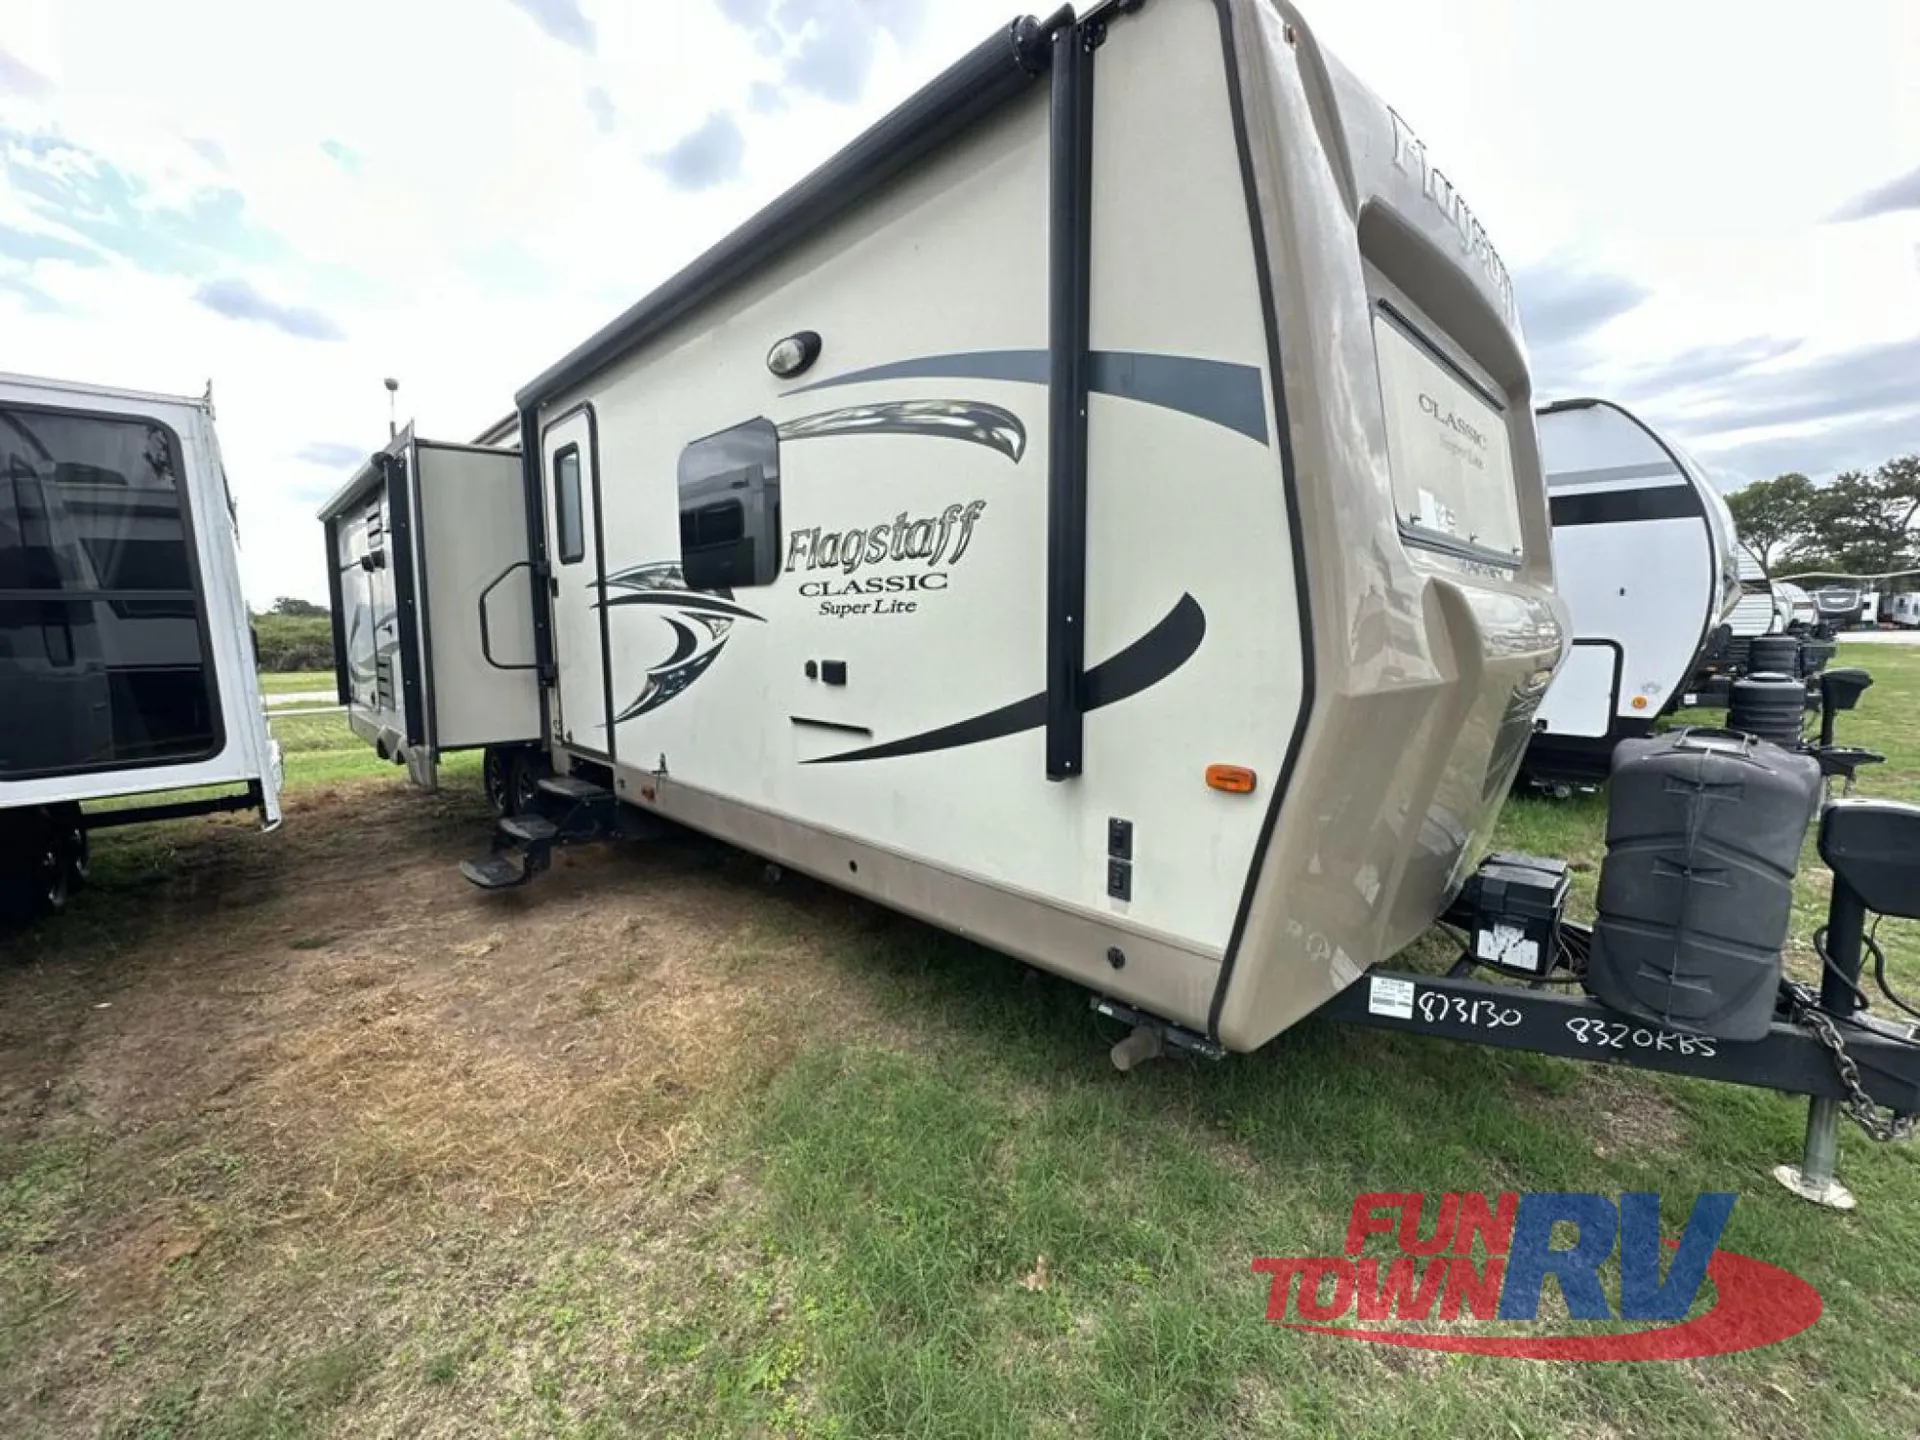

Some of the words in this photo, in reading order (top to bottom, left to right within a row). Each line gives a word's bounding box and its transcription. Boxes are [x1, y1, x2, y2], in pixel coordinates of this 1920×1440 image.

[1418, 392, 1487, 451] CLASSIC
[784, 499, 987, 575] Flagstaff
[798, 572, 948, 597] CLASSIC
[819, 601, 871, 618] Super
[872, 599, 917, 615] Lite
[1418, 991, 1522, 1027] 873130
